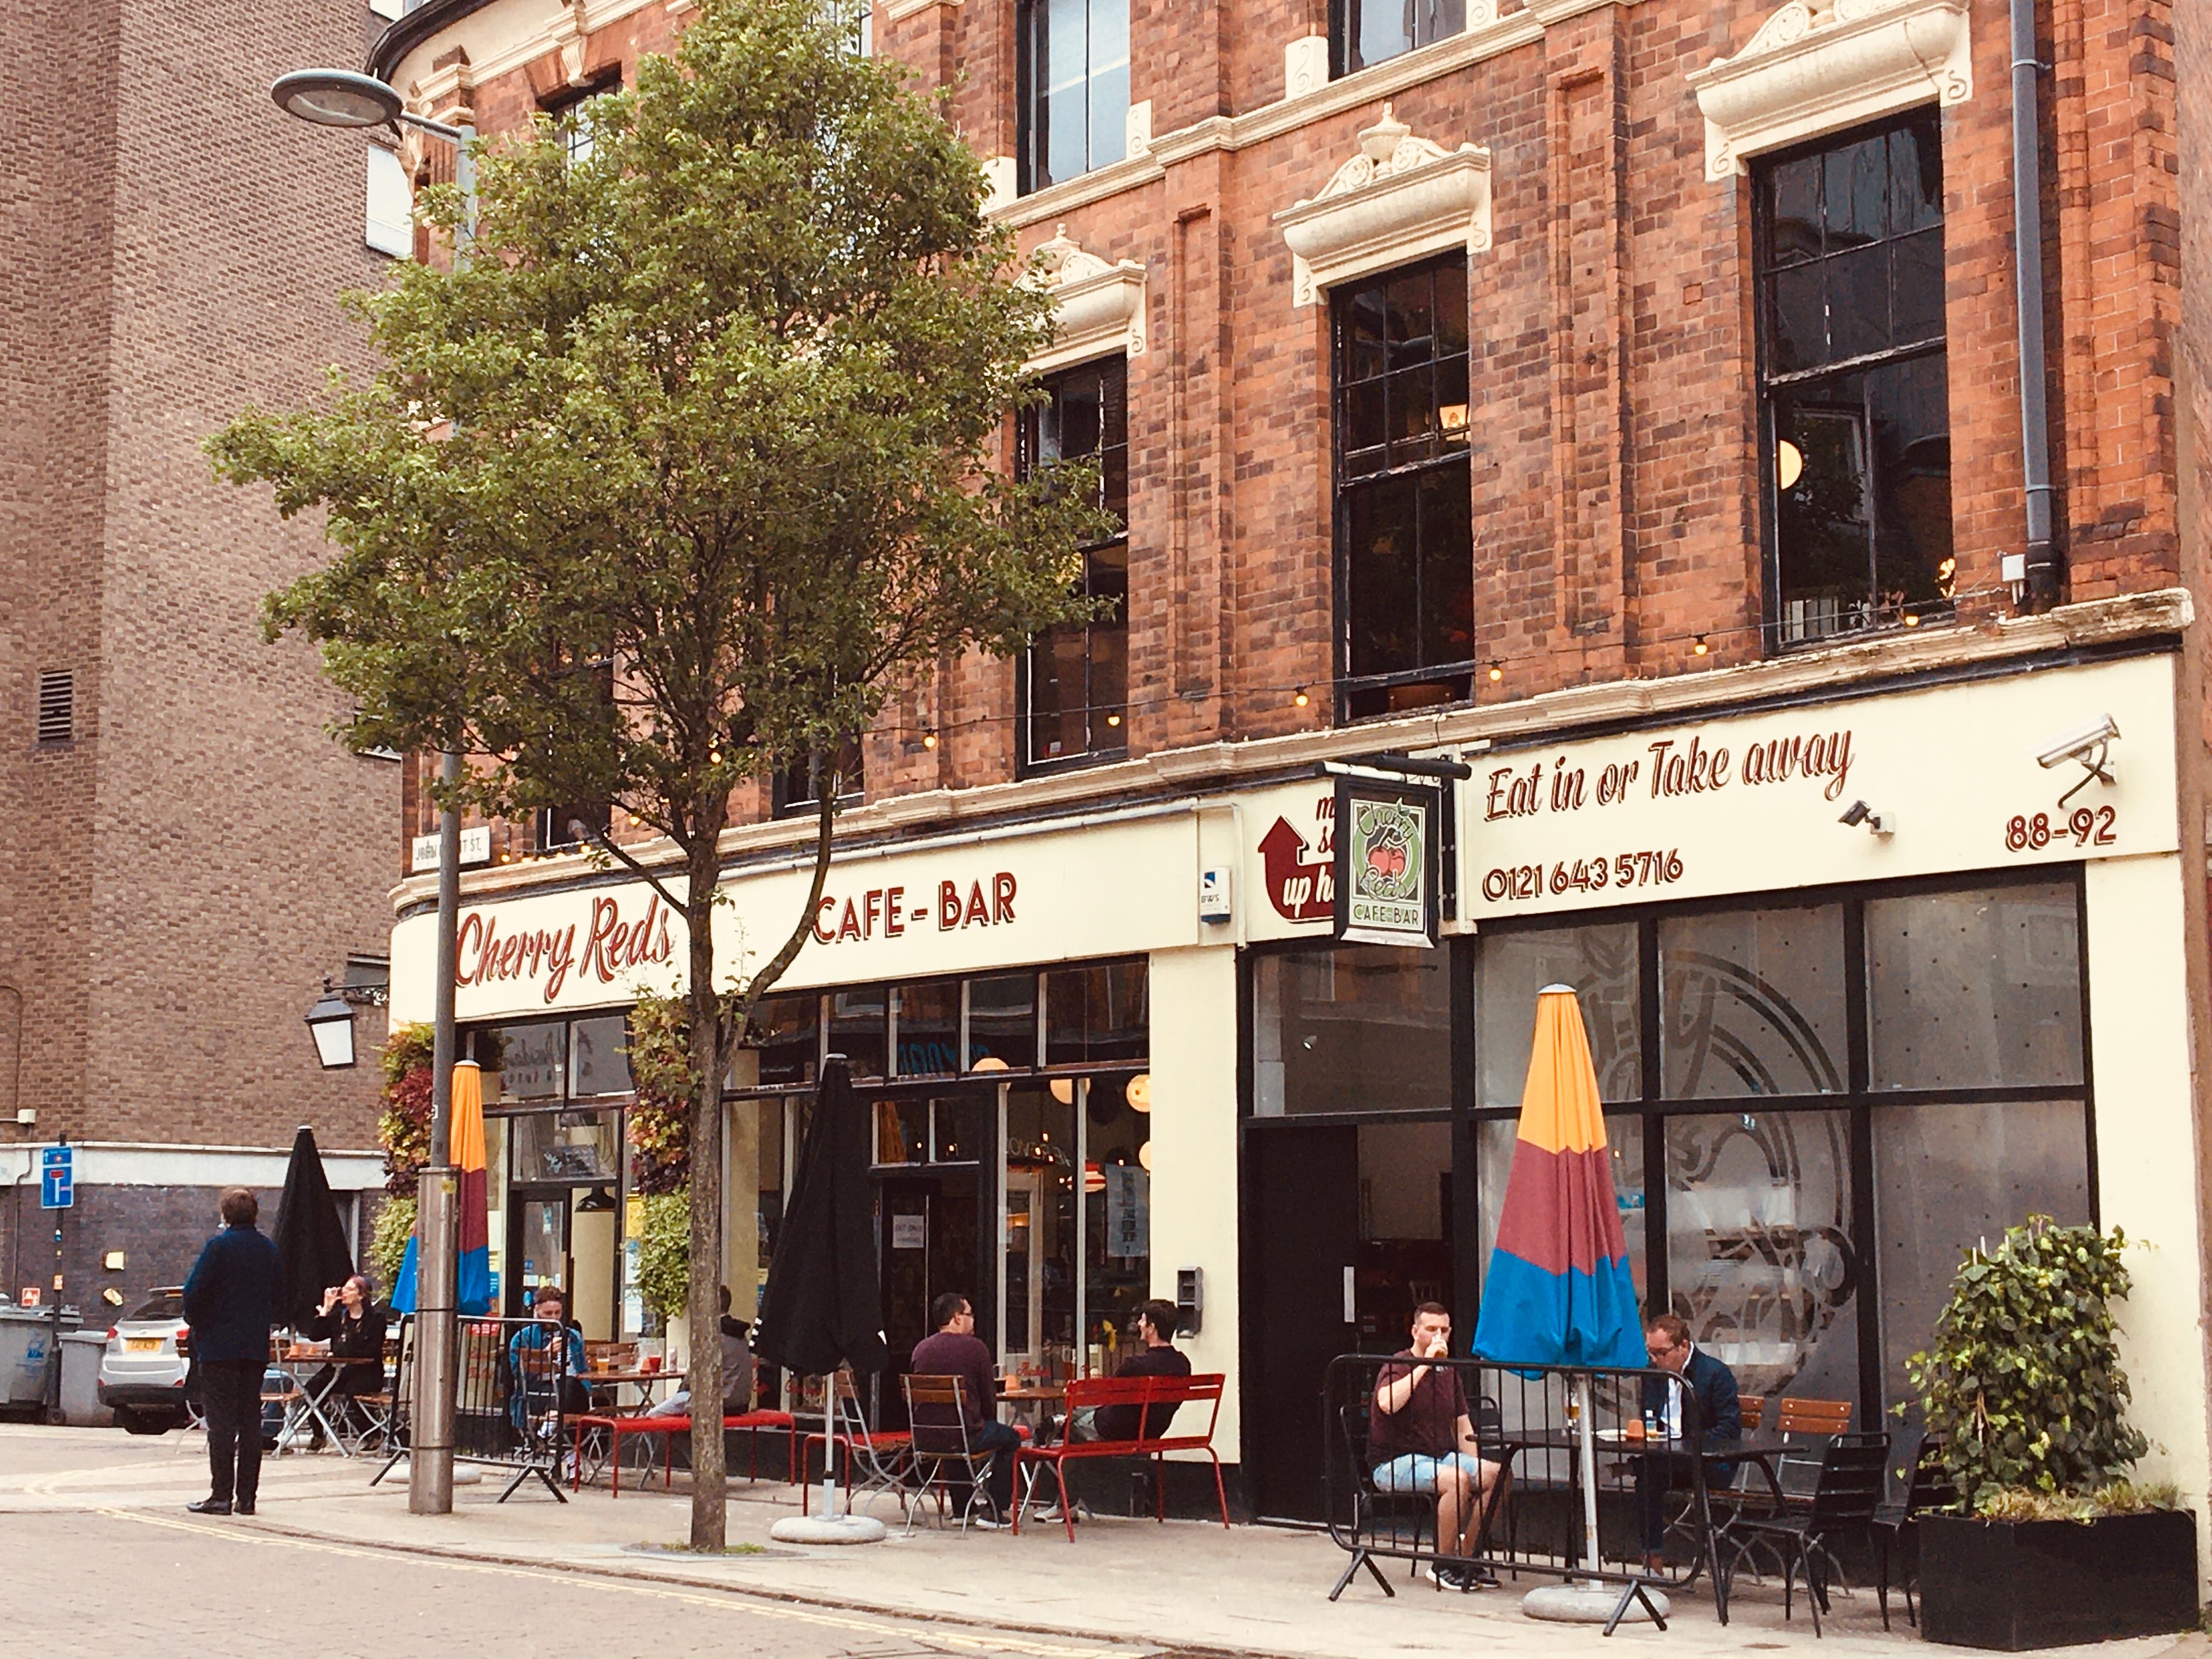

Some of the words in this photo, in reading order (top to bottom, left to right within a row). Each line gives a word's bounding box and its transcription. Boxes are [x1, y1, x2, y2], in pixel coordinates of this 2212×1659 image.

[1484, 763, 1543, 822] Eat
[1551, 756, 1587, 812] in
[1596, 760, 1639, 805] or
[1648, 736, 1729, 799] Take
[1741, 730, 1854, 801] away
[1358, 803, 1414, 847] Cherry
[2005, 805, 2116, 852] 88-92
[1283, 876, 1311, 918] up
[1361, 866, 1407, 900] Reds
[1482, 863, 1543, 902] 0121
[1550, 857, 1608, 895] 643
[1615, 848, 1684, 888] 5716
[456, 912, 575, 1003] Cherry
[579, 893, 671, 983] Reds
